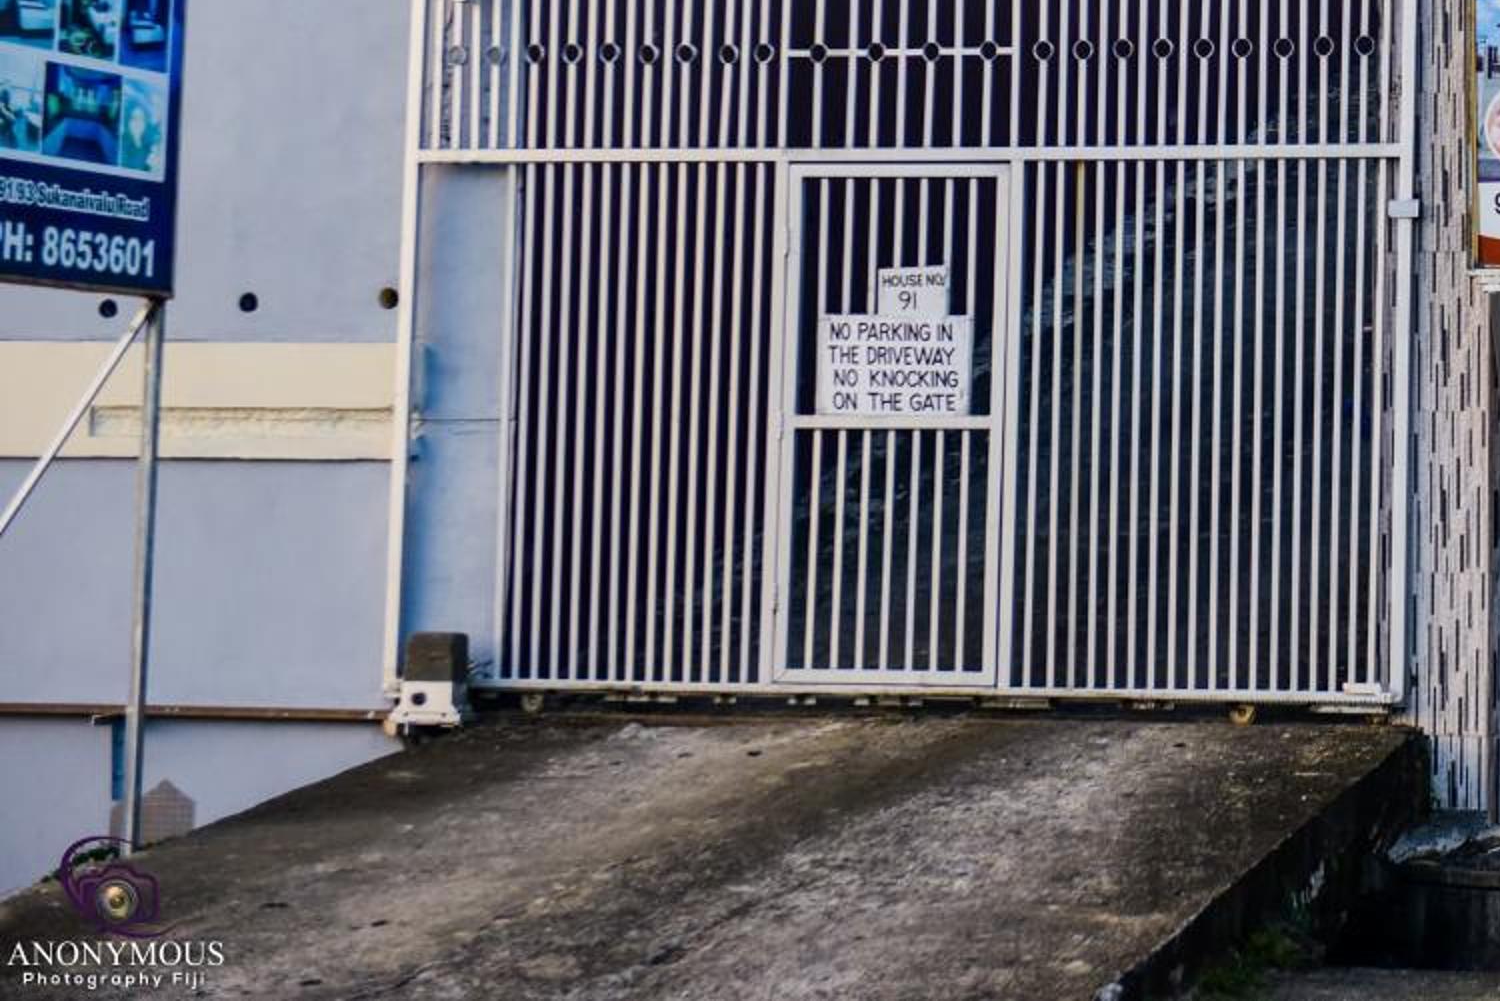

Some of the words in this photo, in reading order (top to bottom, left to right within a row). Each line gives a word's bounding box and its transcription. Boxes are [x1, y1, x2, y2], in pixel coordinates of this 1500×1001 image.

[0, 221, 33, 263] H:
[42, 226, 155, 278] 8653601
[882, 274, 922, 288] HOUSE
[898, 291, 917, 310] 91
[830, 322, 851, 341] NO
[857, 322, 931, 341] PARKING
[936, 323, 953, 341] IN
[829, 345, 859, 364] THE
[866, 346, 955, 365] DRIVEWAY
[833, 369, 858, 387] NO
[869, 370, 959, 388] KNOCKING
[832, 392, 858, 410] ON
[868, 392, 903, 411] THE
[909, 393, 956, 412] GATE
